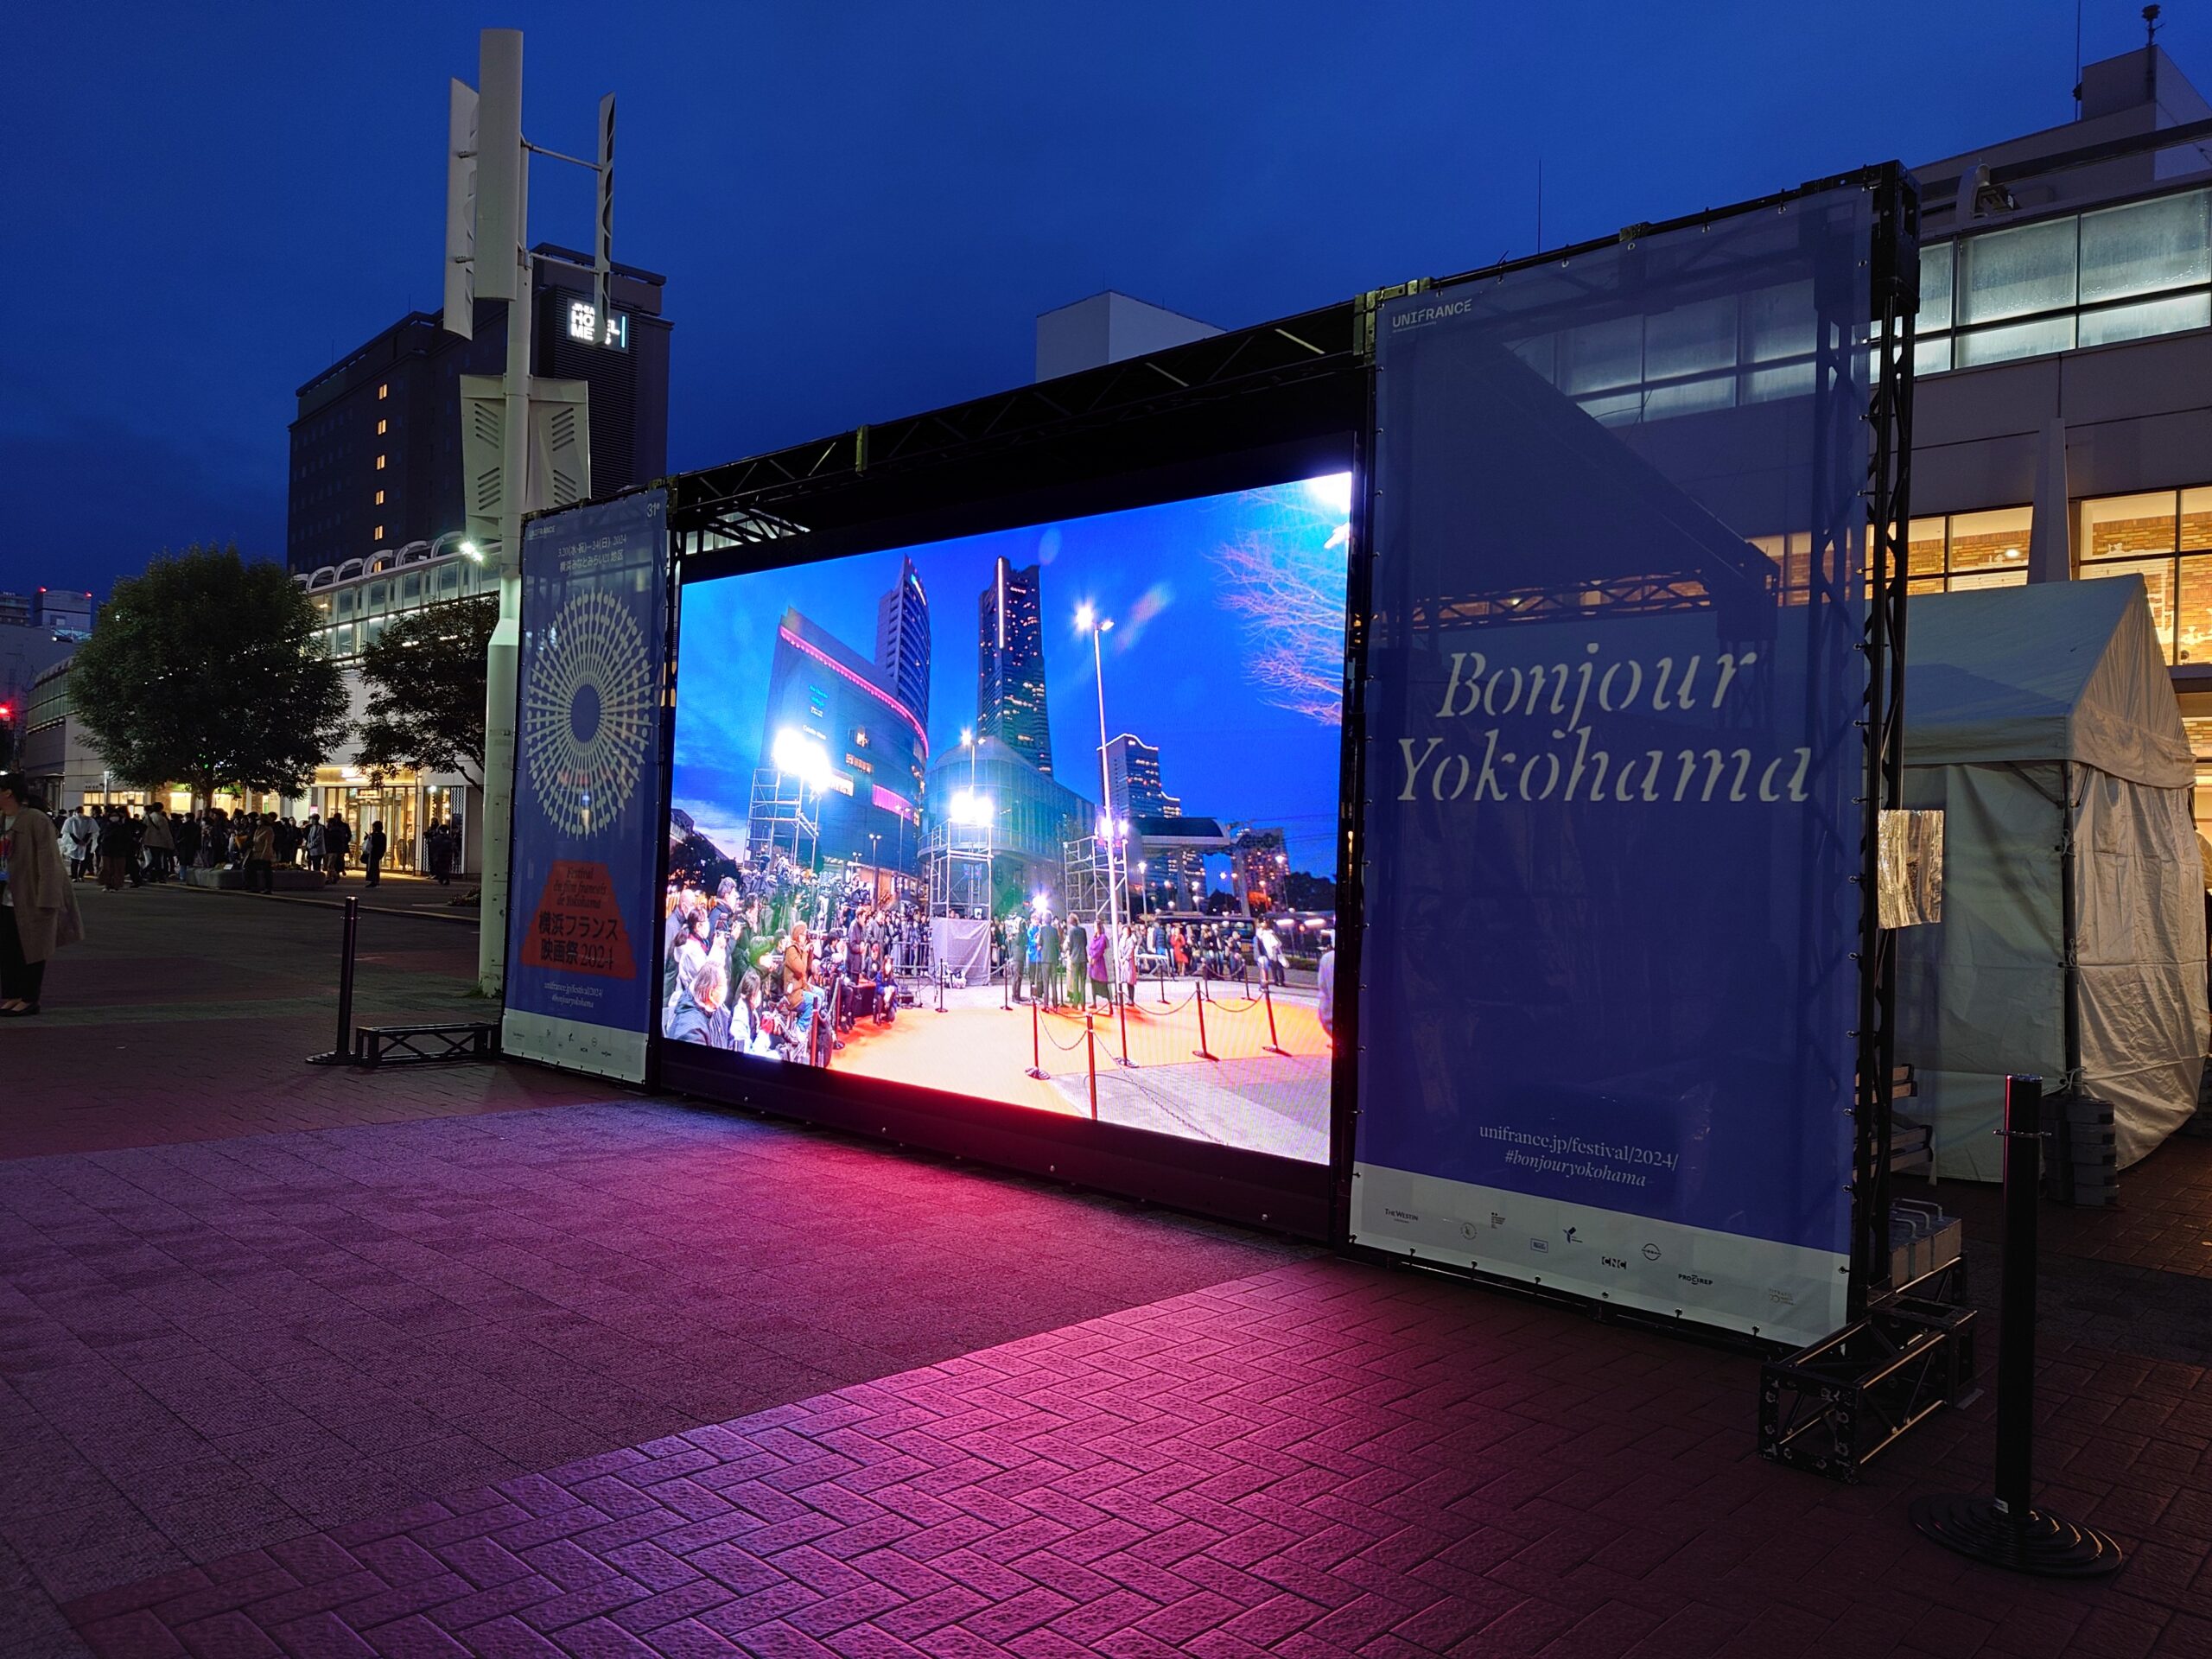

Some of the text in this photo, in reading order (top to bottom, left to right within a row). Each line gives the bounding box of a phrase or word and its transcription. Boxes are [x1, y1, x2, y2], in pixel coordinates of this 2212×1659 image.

[570, 310, 620, 335] HOL
[1392, 298, 1472, 327] UNIFRANCE
[1435, 642, 1758, 739] Bonjour
[1397, 726, 1812, 803] Yokohama
[538, 911, 619, 941] 横浜フランス
[1478, 1125, 1680, 1172] unifrance.jp/festival/2024/
[1504, 1149, 1647, 1187] #bonjouryokohama
[1601, 1255, 1627, 1270] CNC
